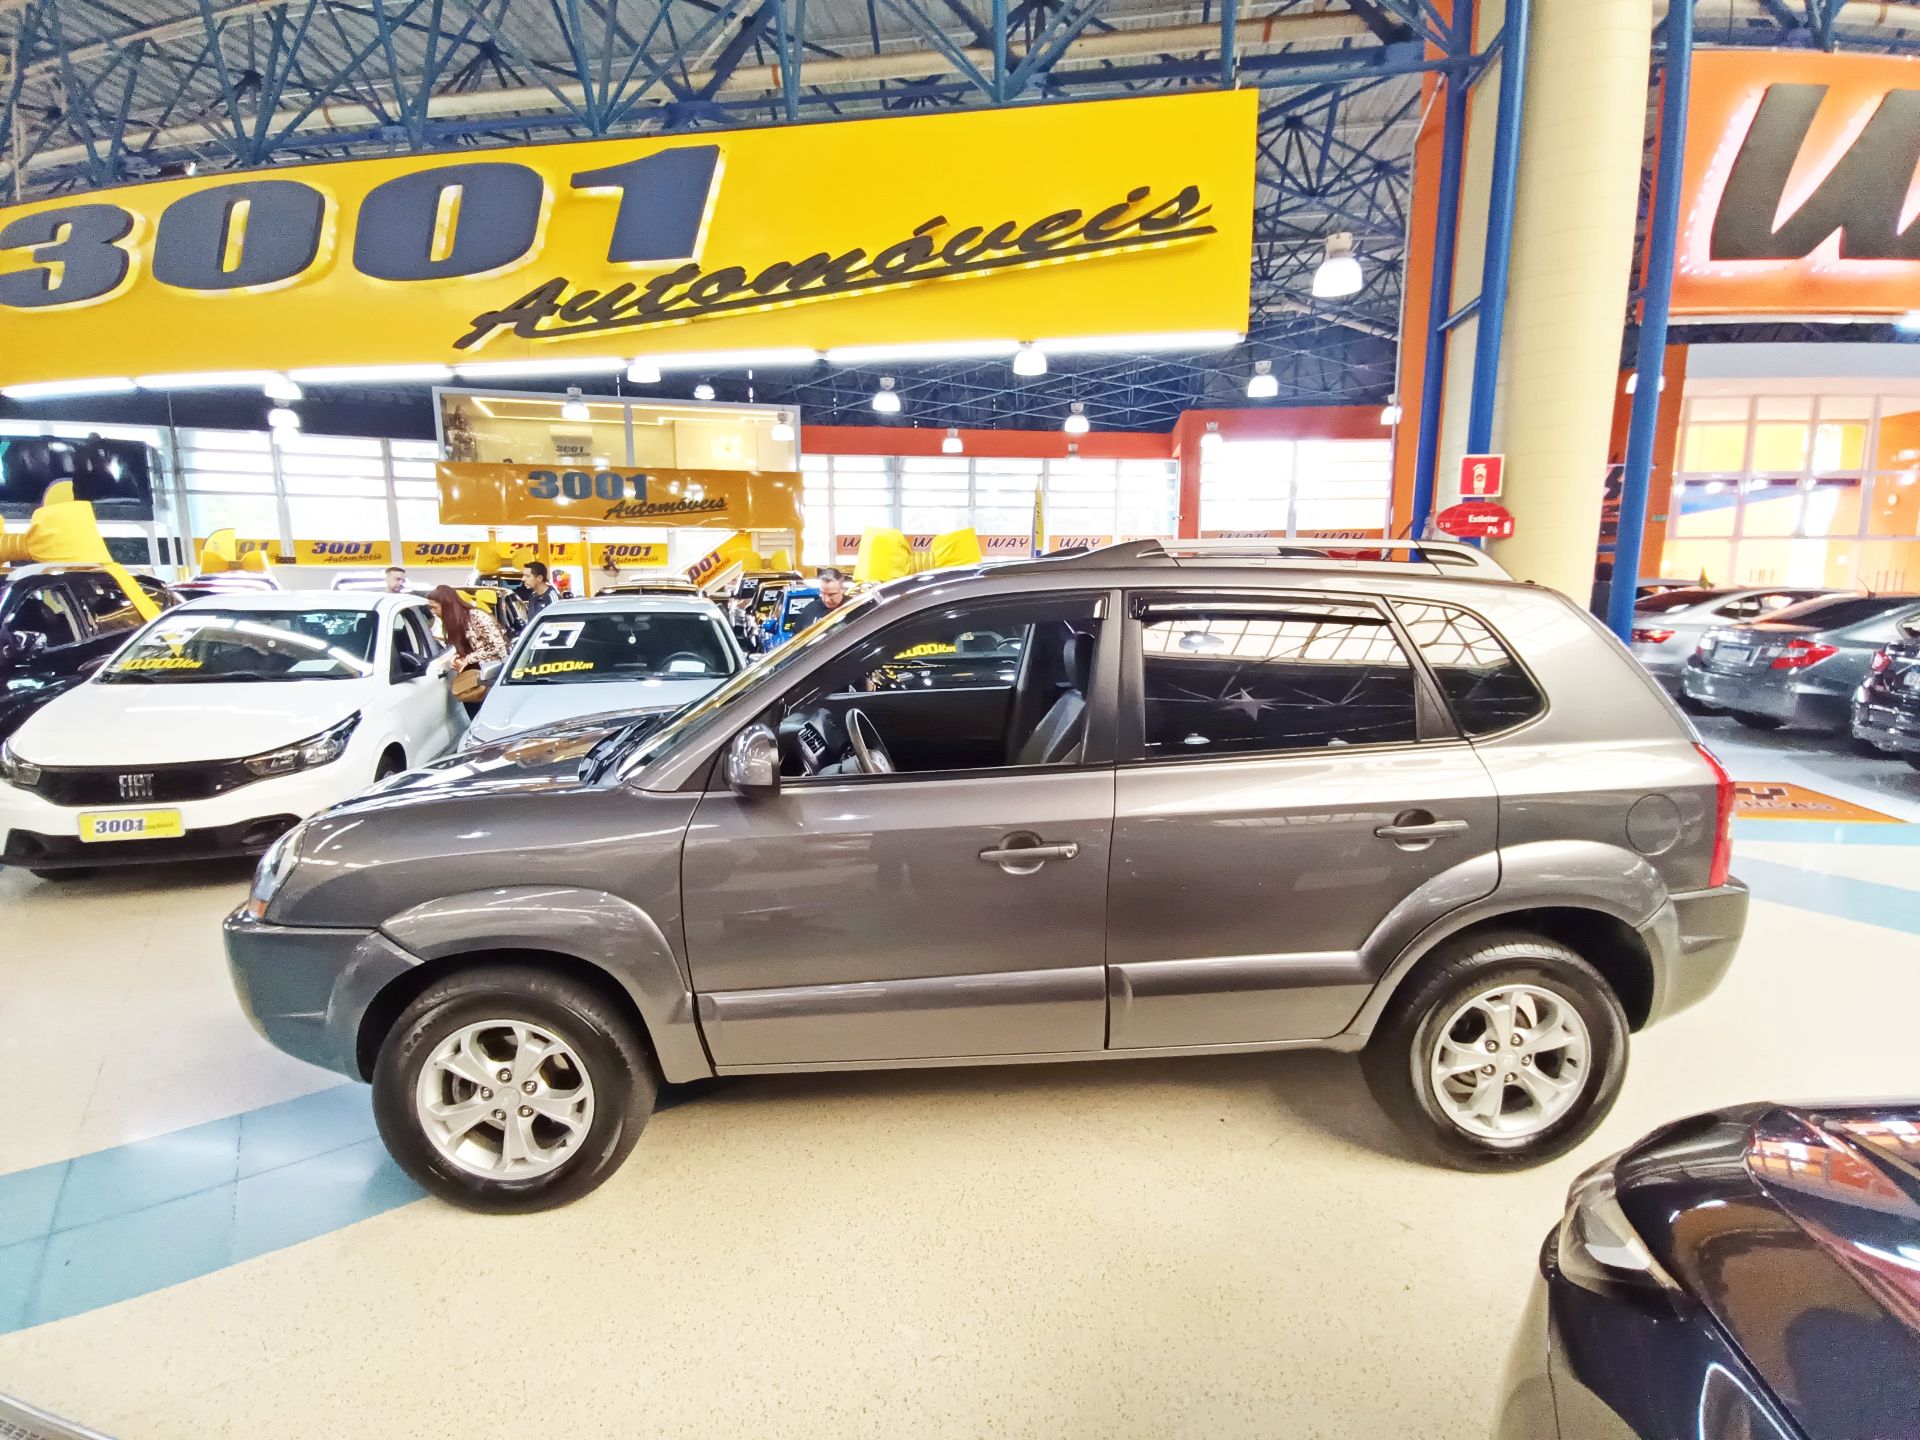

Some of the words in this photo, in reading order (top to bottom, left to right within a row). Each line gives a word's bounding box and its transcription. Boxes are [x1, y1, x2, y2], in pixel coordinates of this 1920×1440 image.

[0, 145, 722, 308] 3001
[454, 185, 1217, 351] Automóveis
[527, 470, 648, 501] 3001
[603, 497, 729, 520] Automóveis
[311, 543, 373, 554] 3001
[415, 543, 471, 555] 3001
[603, 545, 652, 556] 3001
[987, 538, 1029, 548] WAY
[687, 551, 721, 584] 001
[119, 774, 154, 797] FIAT
[95, 819, 144, 833] 3001
